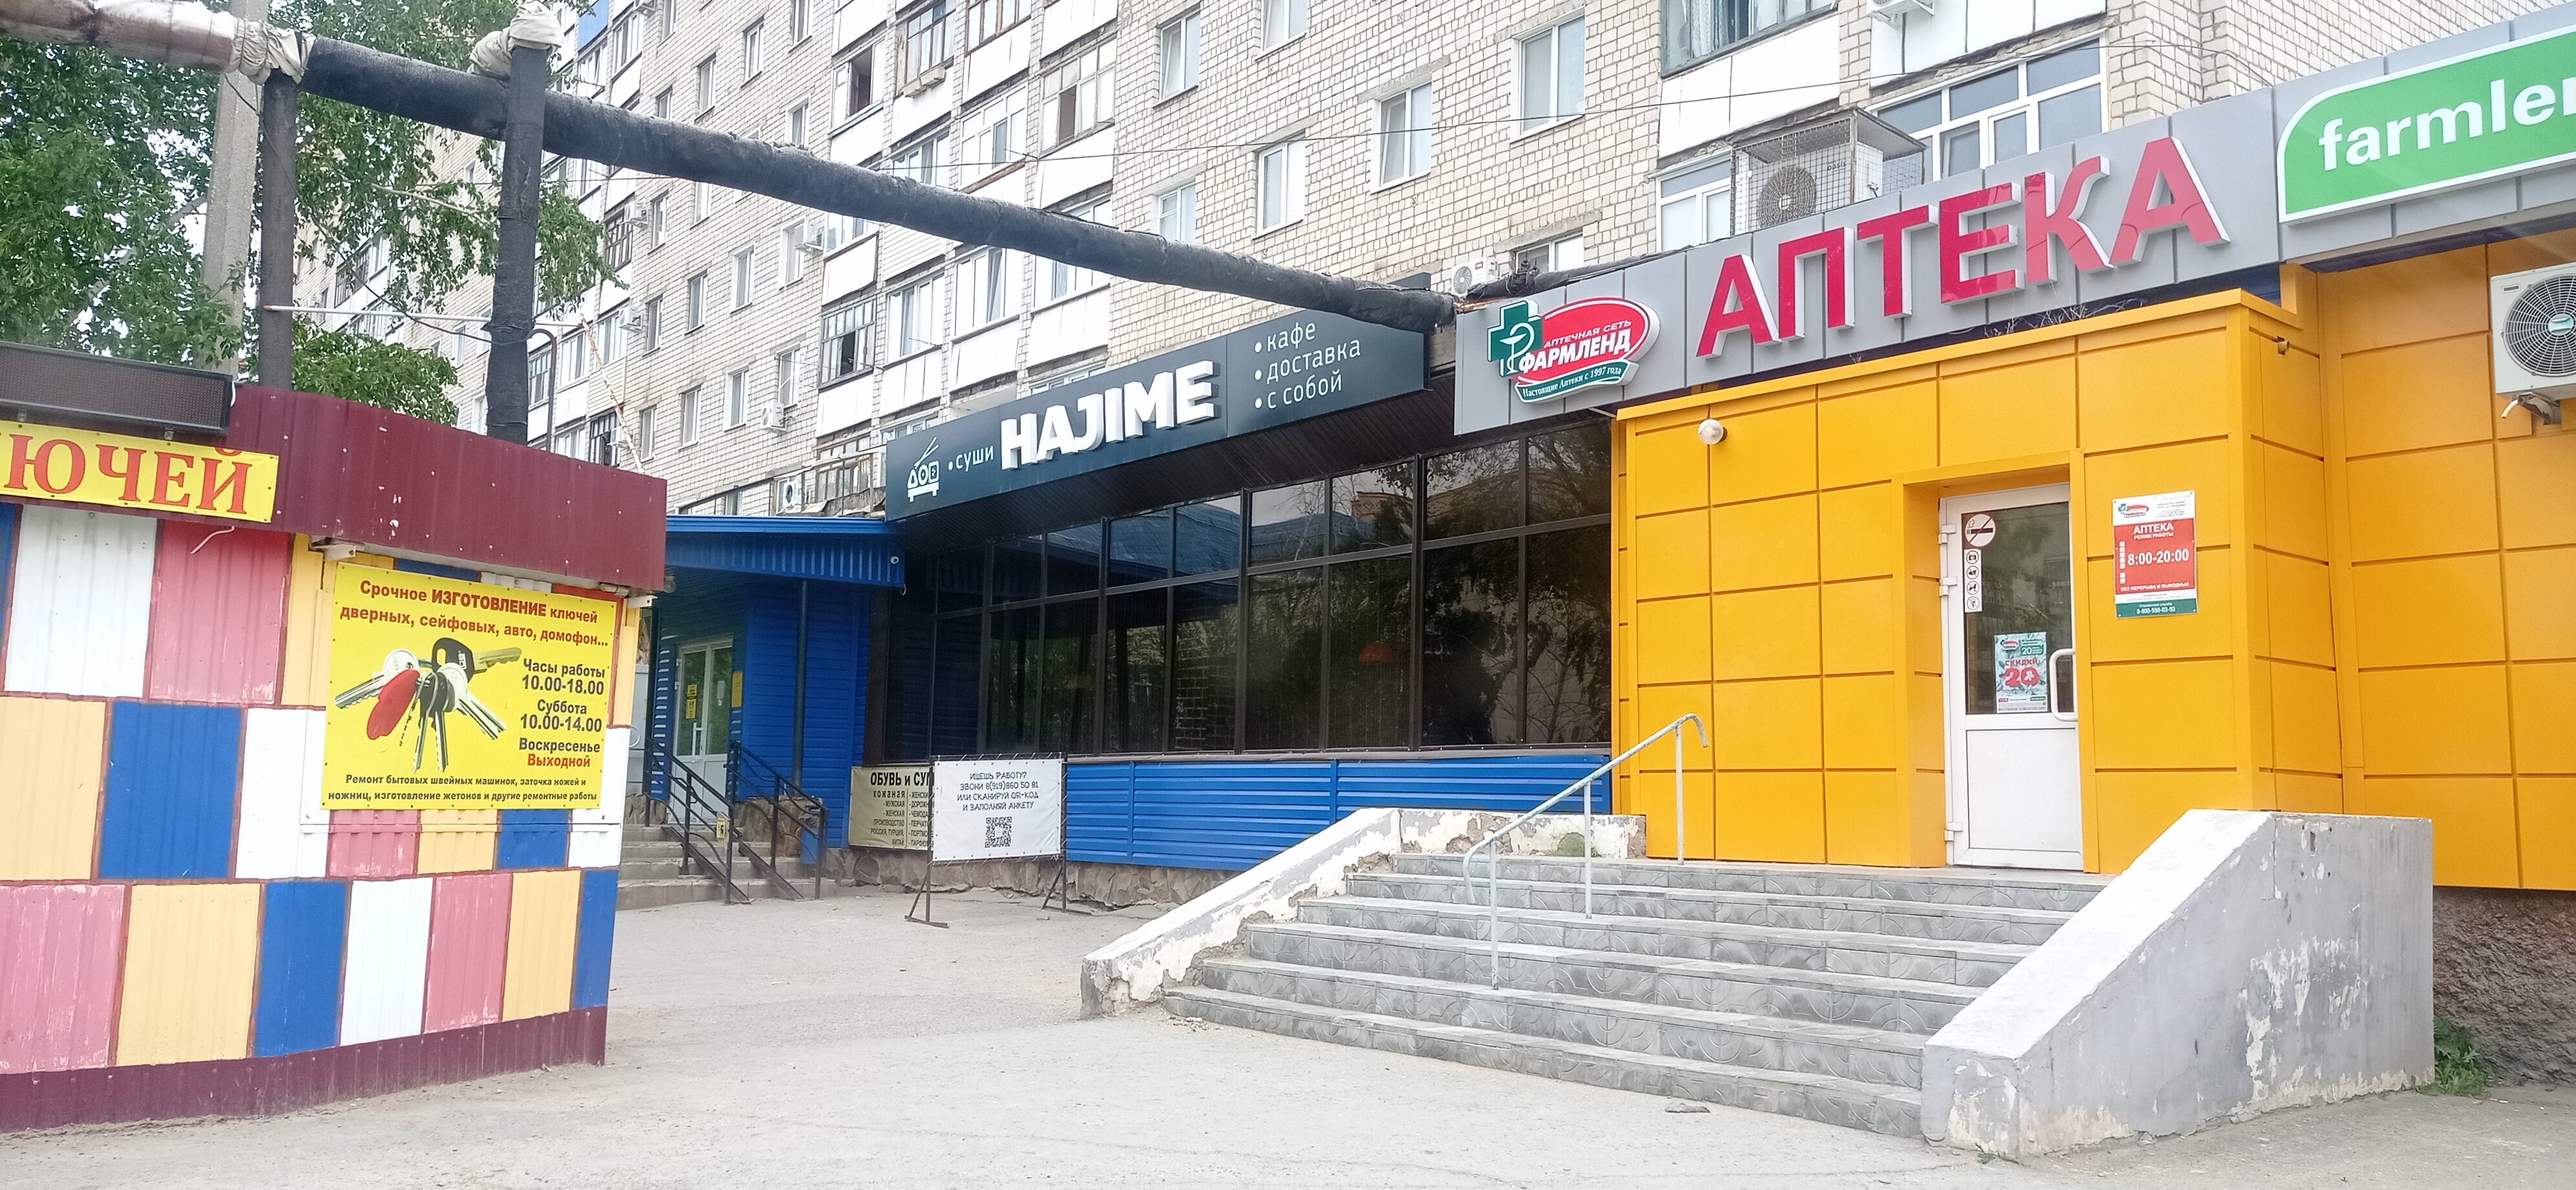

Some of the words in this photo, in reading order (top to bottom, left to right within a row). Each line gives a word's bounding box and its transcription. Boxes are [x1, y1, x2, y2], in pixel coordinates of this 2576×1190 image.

[1697, 136, 2230, 359] АПТЕКА
[1267, 322, 1316, 352] кафе
[1543, 327, 1600, 349] АПТЕЧНАЯ
[1604, 320, 1631, 334] СЕТЬ
[1519, 329, 1631, 373] ФАРМЛЕНД
[1267, 340, 1360, 384] доставка
[1268, 391, 1276, 409] с
[1283, 369, 1341, 405] собой
[1523, 383, 1558, 397] Настоящие
[1559, 375, 1583, 389] Аптеки
[1591, 367, 1606, 378] 1997
[1607, 367, 1622, 376] года
[1001, 360, 1215, 470] HAJIME
[956, 446, 994, 472] суши
[2133, 523, 2174, 534] АПТЕКА
[2127, 548, 2189, 566] 8:00-20:00
[360, 579, 427, 601] Срочное
[431, 589, 547, 617] ИЗГОТОВЛЕНИЕ
[550, 608, 597, 623] ключей
[340, 605, 414, 627] дверных,
[420, 613, 499, 636] сейфовых,
[504, 624, 537, 640] авто,
[540, 631, 608, 647] домофон...
[523, 658, 557, 673] Часы
[561, 664, 605, 678] работы
[2004, 667, 2039, 687] 20
[522, 675, 604, 695] 10.00-18.00
[537, 699, 587, 715] Суббота
[521, 713, 602, 732] 10.00-14.00
[519, 737, 601, 753] Воскресенье
[528, 753, 590, 768] Выходной
[346, 775, 383, 783] Ремонт
[386, 775, 428, 784] бытовых
[431, 776, 473, 784] швейных
[475, 778, 517, 786] машинок,
[554, 777, 579, 786] ножей
[870, 772, 901, 786] ОБУВЬ
[905, 775, 910, 786] и
[985, 781, 1018, 791] 8(919)860
[328, 792, 371, 801] ножниц,
[491, 792, 522, 801] другие
[523, 793, 567, 802] ремонтные
[569, 792, 597, 801] работы
[973, 792, 1009, 800] СКАНИРУЙ
[970, 802, 1006, 811] ЗАПОЛНЯЙ
[874, 819, 905, 827] ПРОИЗВОДСТВО
